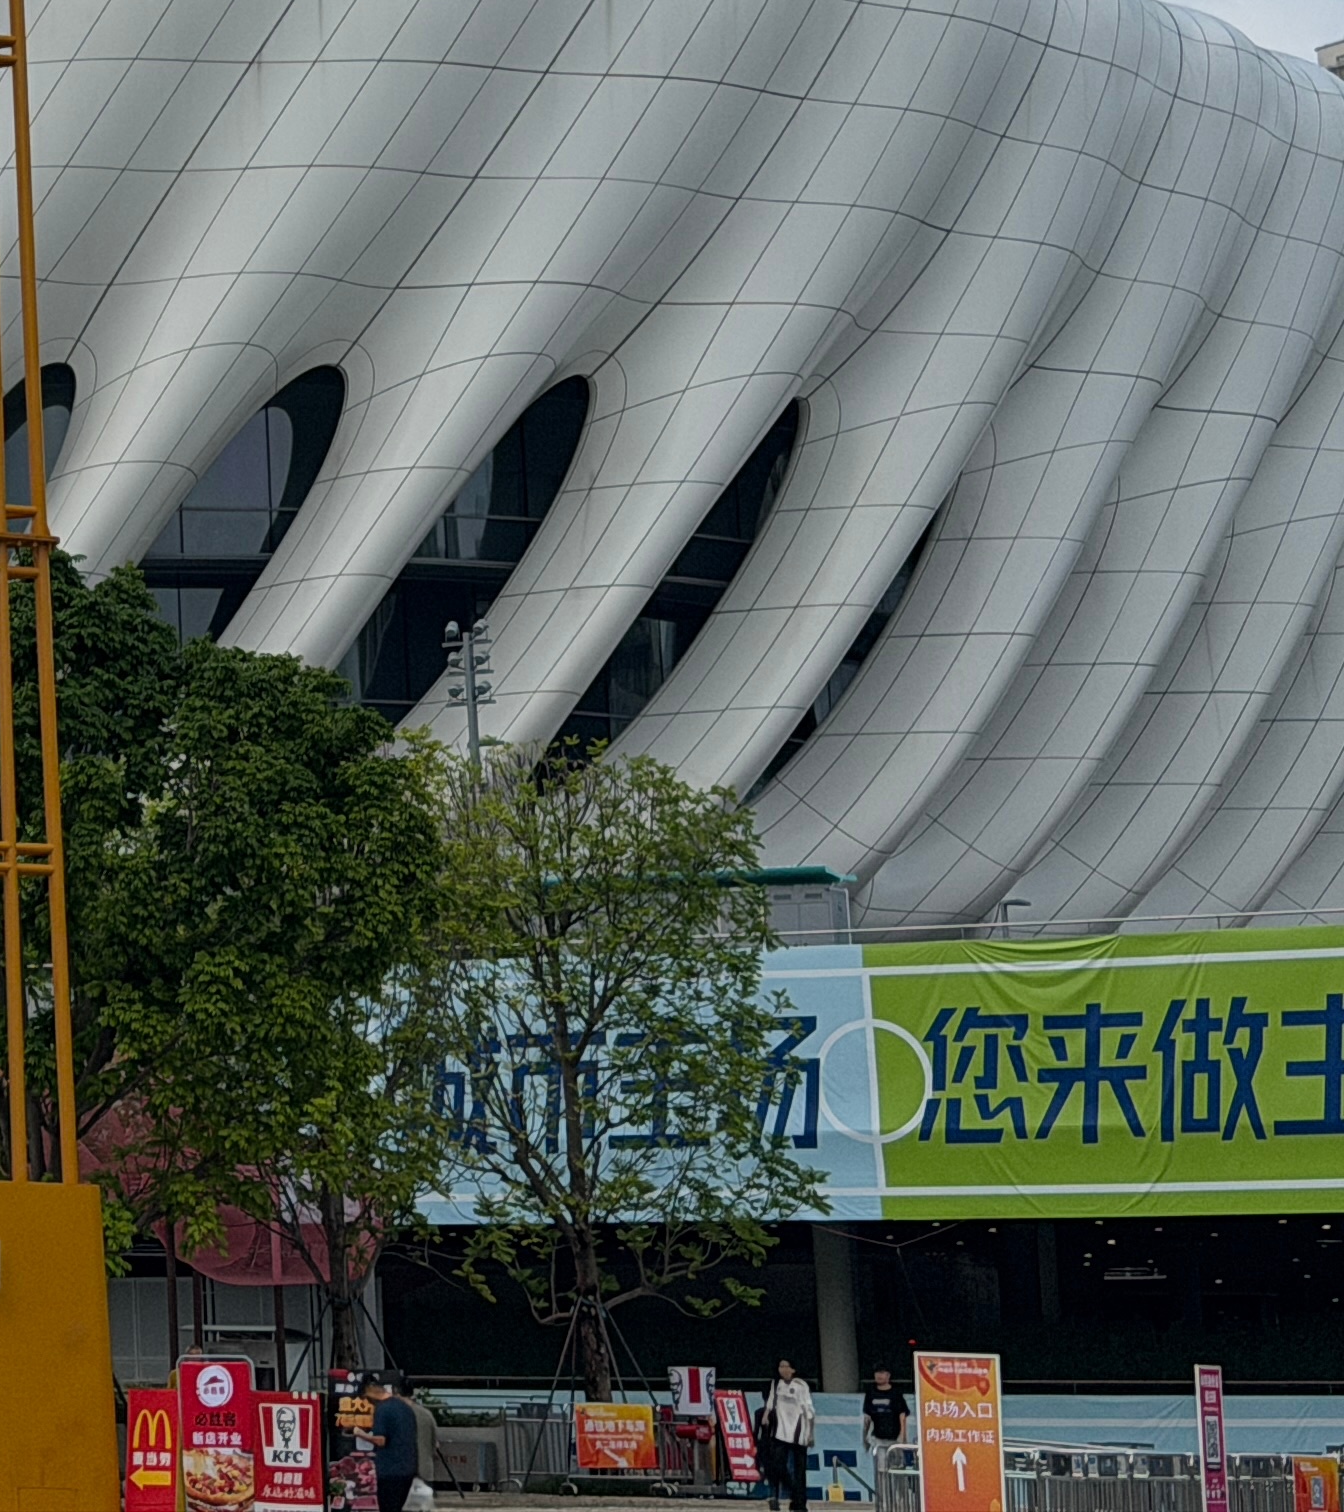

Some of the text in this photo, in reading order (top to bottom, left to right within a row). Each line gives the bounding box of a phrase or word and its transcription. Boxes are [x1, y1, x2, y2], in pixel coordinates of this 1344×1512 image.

[918, 993, 1344, 1145] 您来做主
[924, 1399, 993, 1419] 内场入口
[192, 1431, 242, 1446] 新店开业
[926, 1427, 995, 1444] 内场工作证
[271, 1449, 304, 1464] KFC
